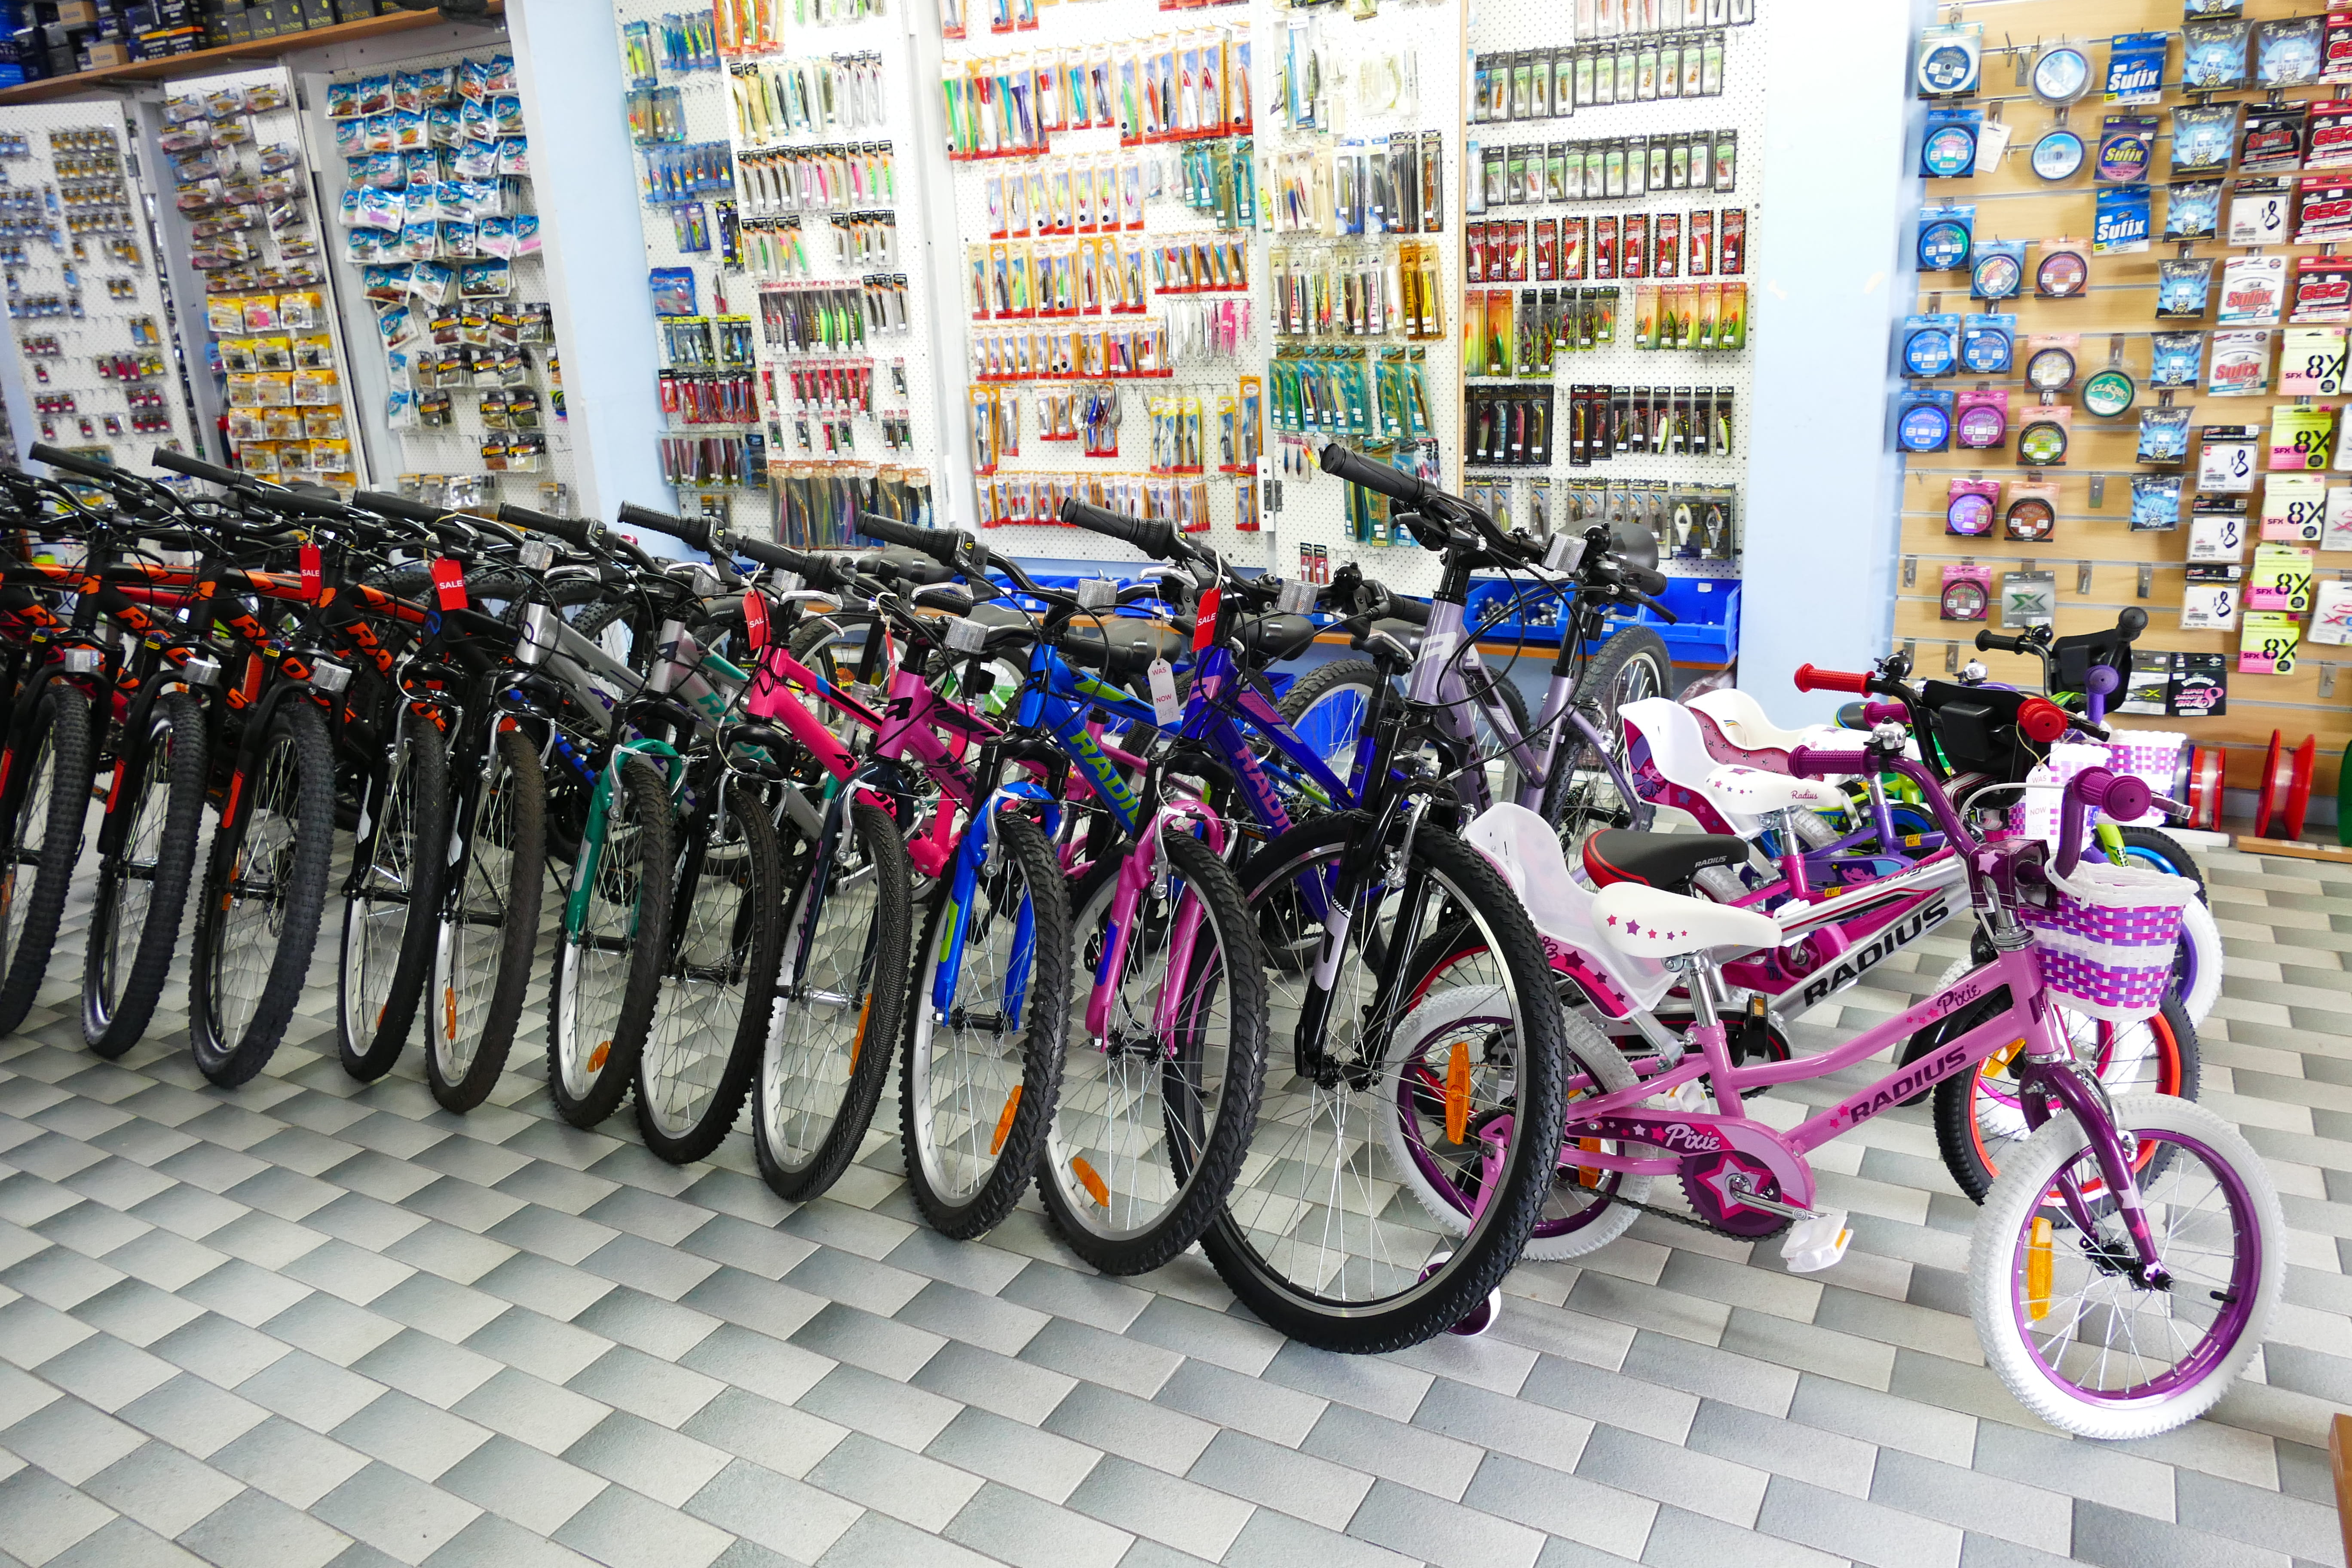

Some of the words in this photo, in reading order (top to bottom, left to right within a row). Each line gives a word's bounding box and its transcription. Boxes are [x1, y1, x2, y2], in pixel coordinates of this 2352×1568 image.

[2108, 69, 2159, 92] Sufix
[2248, 129, 2293, 150] Sufix
[2106, 147, 2144, 162] Sufix
[2302, 199, 2352, 222] 832
[2097, 218, 2146, 241] Sufix
[2227, 289, 2275, 307] Sufix
[2298, 281, 2351, 302] 832
[2255, 303, 2274, 317] 21
[2215, 362, 2261, 380] Sufix
[2306, 354, 2345, 379] 8X
[2243, 376, 2261, 389] 21
[2091, 383, 2128, 401] CLASSIC
[2294, 430, 2331, 454] 8X
[2287, 501, 2325, 525] 8X
[439, 580, 463, 589] SALE
[2275, 573, 2312, 595] 8X
[710, 609, 734, 618] APOLLO
[1197, 612, 1216, 626] SALE
[2262, 638, 2299, 660] 8X
[1152, 667, 1166, 676] WAS
[2181, 676, 2216, 687] SCHNEIDER
[1156, 693, 1172, 703] NOW
[2032, 775, 2047, 784] WAS
[1791, 789, 1818, 799] Radius
[2030, 806, 2046, 816] NOW
[1695, 856, 1727, 868] RADIUS
[1804, 897, 1949, 1007] RADIUS
[1937, 984, 1981, 1014] Pixie
[1850, 1045, 1966, 1124] RADIUS
[1665, 1123, 1721, 1151] Pixie
